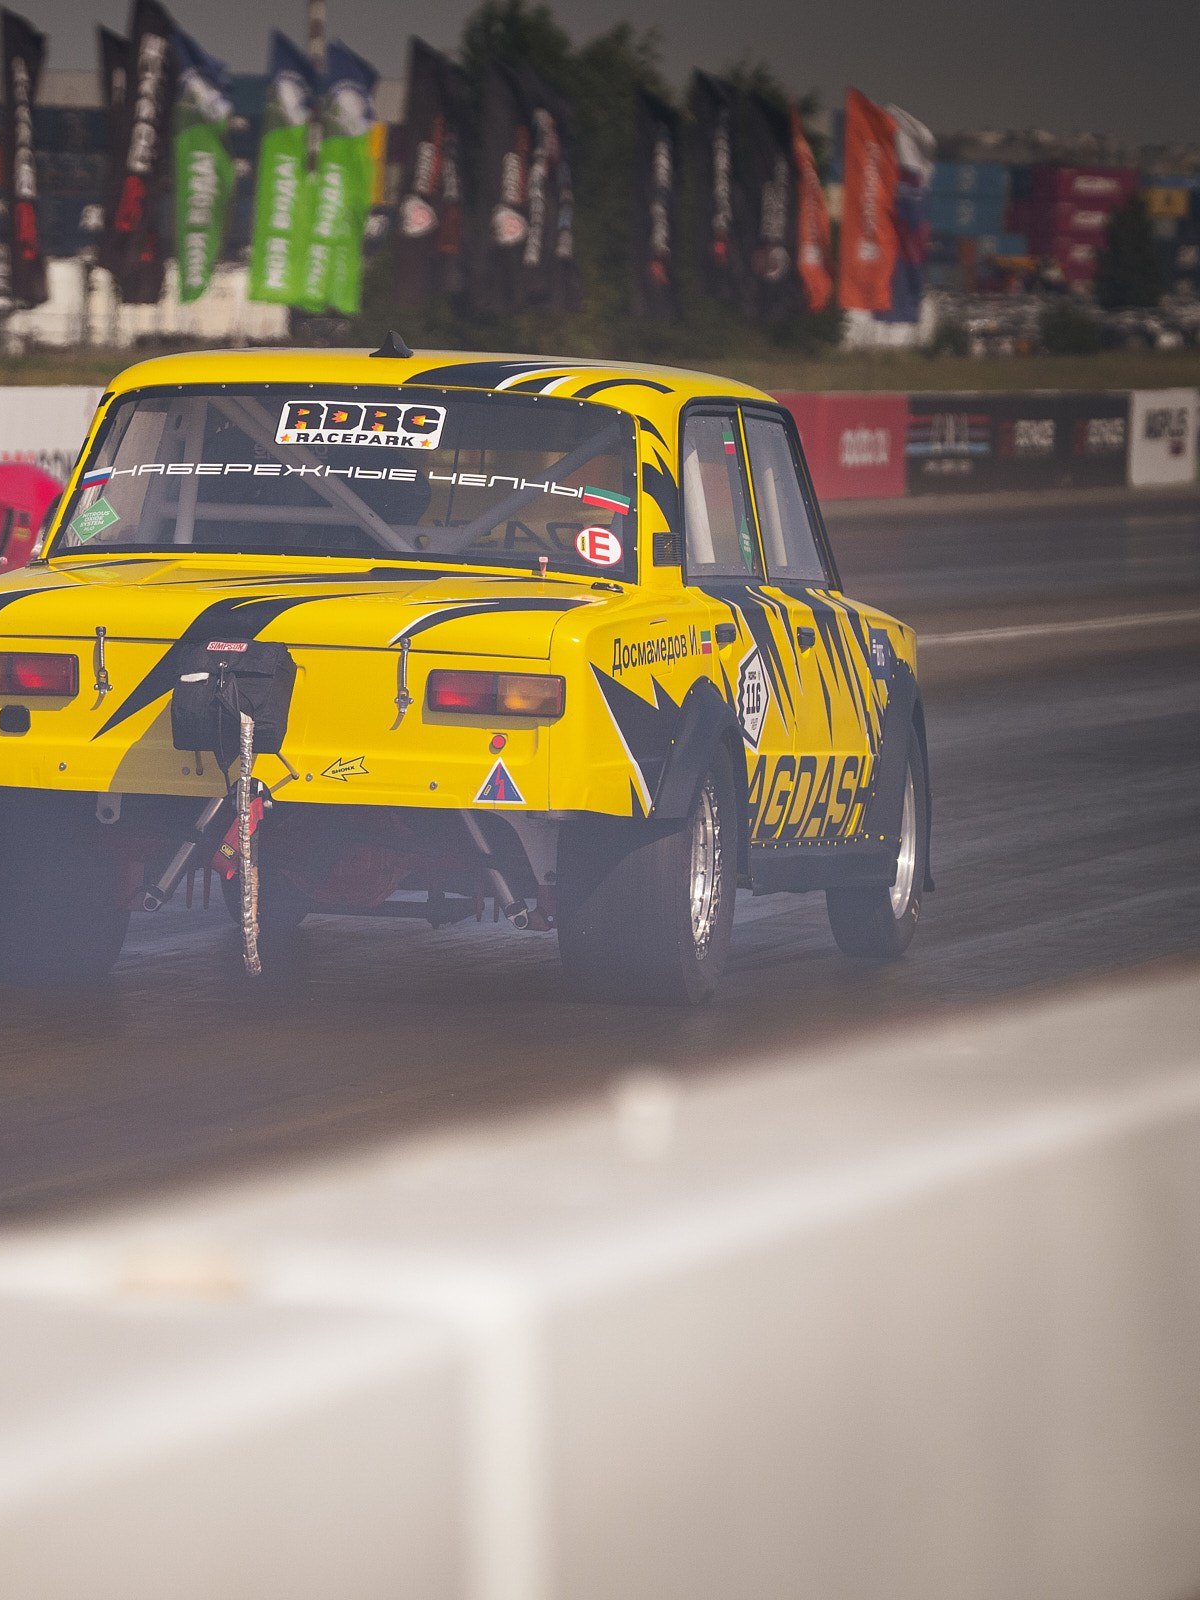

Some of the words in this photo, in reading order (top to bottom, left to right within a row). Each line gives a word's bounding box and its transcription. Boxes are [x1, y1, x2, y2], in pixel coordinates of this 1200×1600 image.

[284, 402, 442, 435] RDRC
[295, 432, 416, 447] RACEPARK
[110, 463, 418, 482] НАБЕРЕЖНЫЕ
[428, 471, 584, 498] ЧЕЛНЫ
[588, 530, 610, 562] E
[208, 642, 245, 651] SIMPSON
[612, 634, 688, 678] Досмамедов
[745, 682, 761, 715] 116
